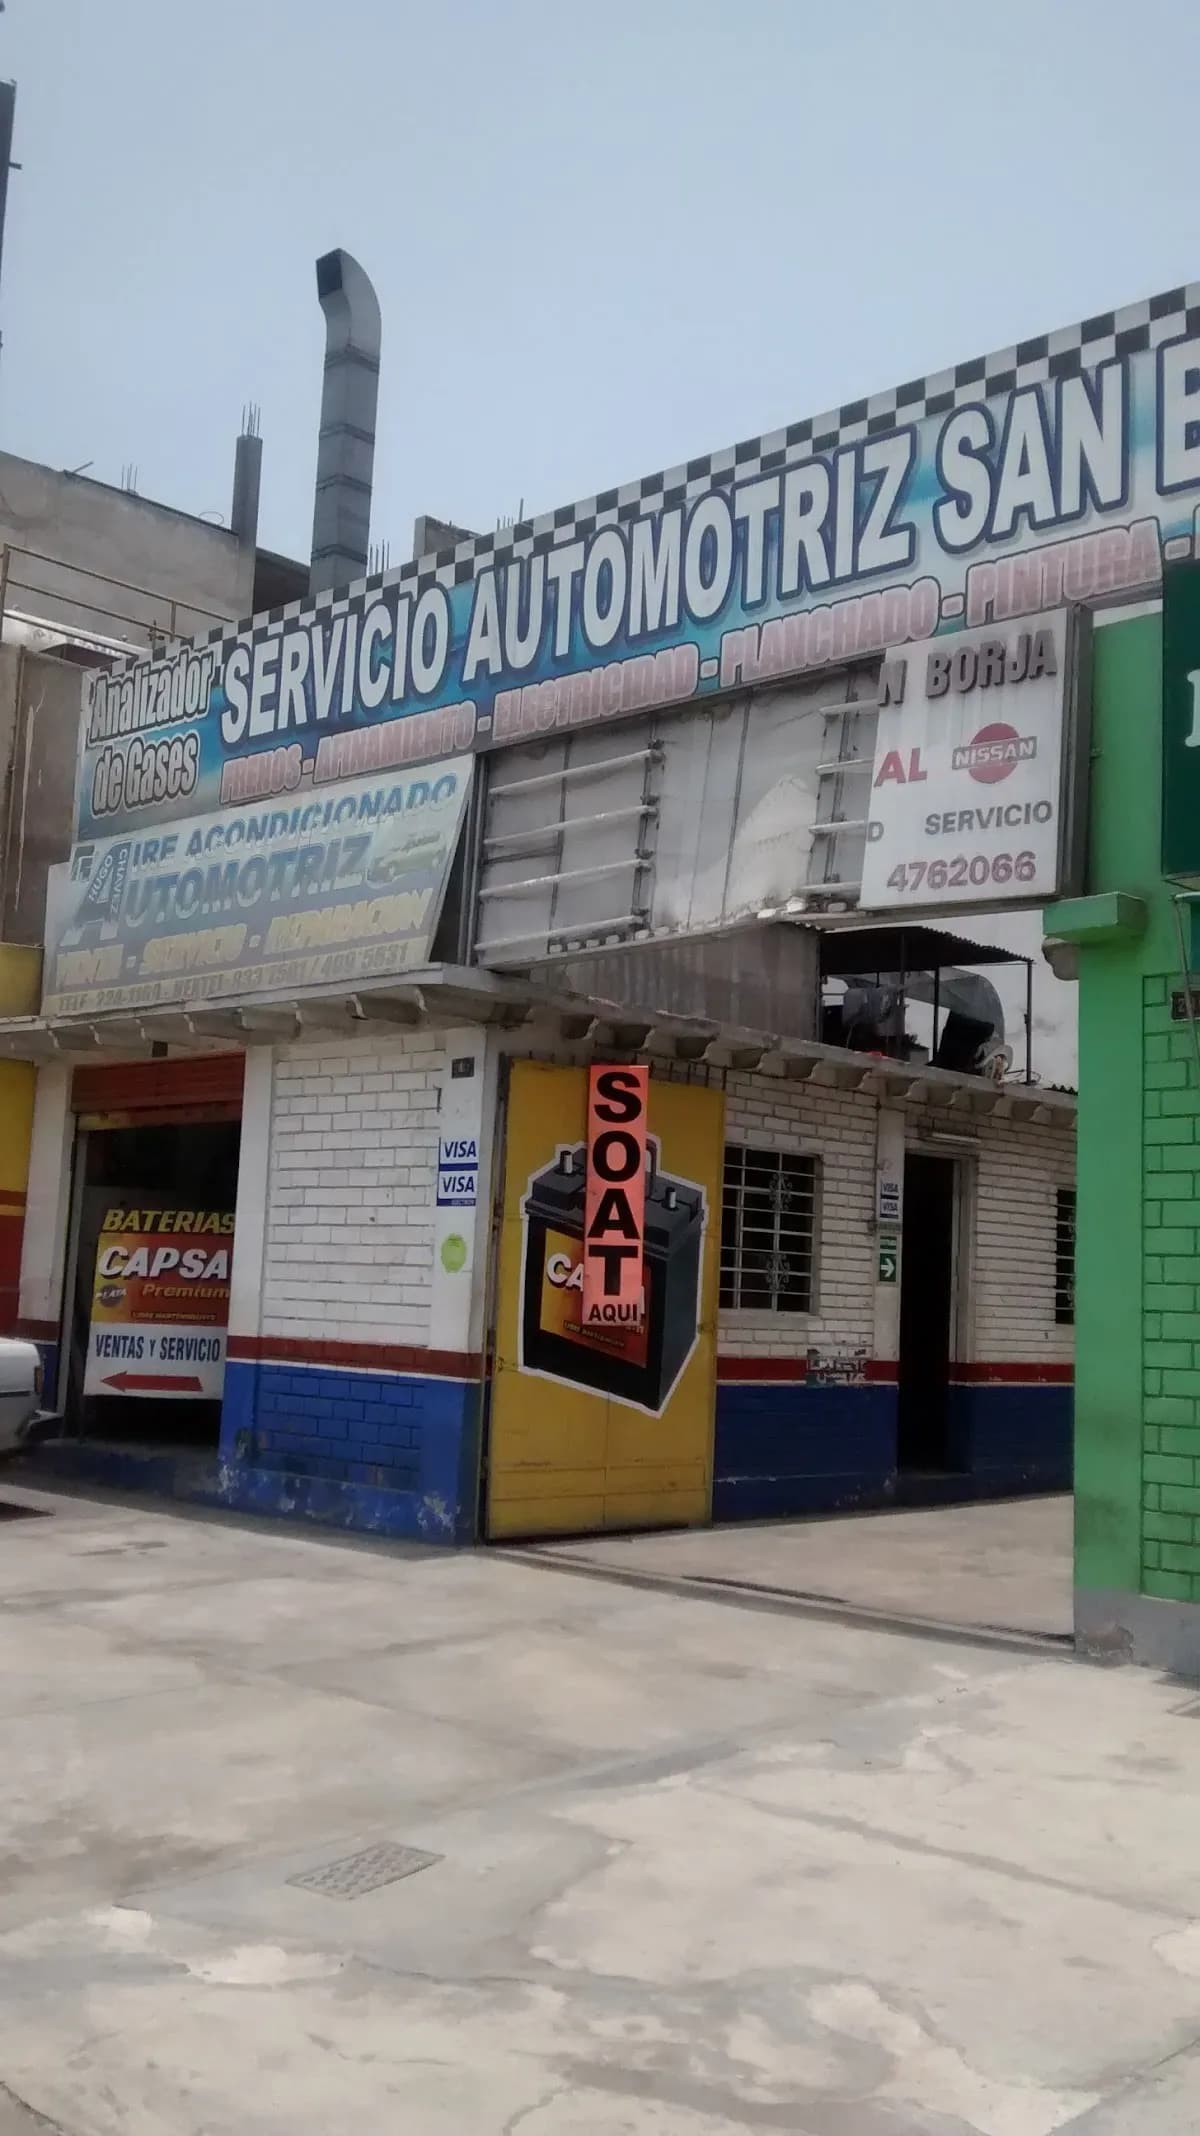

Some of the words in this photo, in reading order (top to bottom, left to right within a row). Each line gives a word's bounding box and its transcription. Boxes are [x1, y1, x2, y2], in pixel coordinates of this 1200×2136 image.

[220, 588, 449, 744] SERVICIO
[462, 432, 914, 683] AUTOMOTRIZ
[939, 359, 1123, 548] SAN
[220, 742, 302, 805] FRENOS
[314, 701, 476, 785] AFINAMIENTO
[493, 643, 699, 742] ELECTRICIDAD
[720, 576, 940, 688] PLANCHADO
[966, 515, 1163, 628] PINTURA
[925, 629, 1057, 700] BORJA
[89, 649, 214, 741] Analizador
[125, 736, 199, 808] Gases
[873, 747, 928, 788] AL
[954, 738, 1037, 768] NISSAN
[92, 746, 125, 814] de
[186, 775, 458, 858] ACONDICIONADO
[924, 800, 1054, 836] SERVICIO
[886, 850, 1037, 893] 4762066
[444, 1140, 477, 1158] VISA
[442, 1175, 475, 1193] VISA
[588, 1071, 643, 1297] SOAT
[102, 1208, 236, 1235] BATERIAS
[99, 1246, 228, 1280] CAPSA
[588, 1303, 638, 1322] AQUI
[96, 1334, 145, 1360] VENTAS
[149, 1339, 156, 1358] Y
[159, 1336, 220, 1362] SERVICIO
